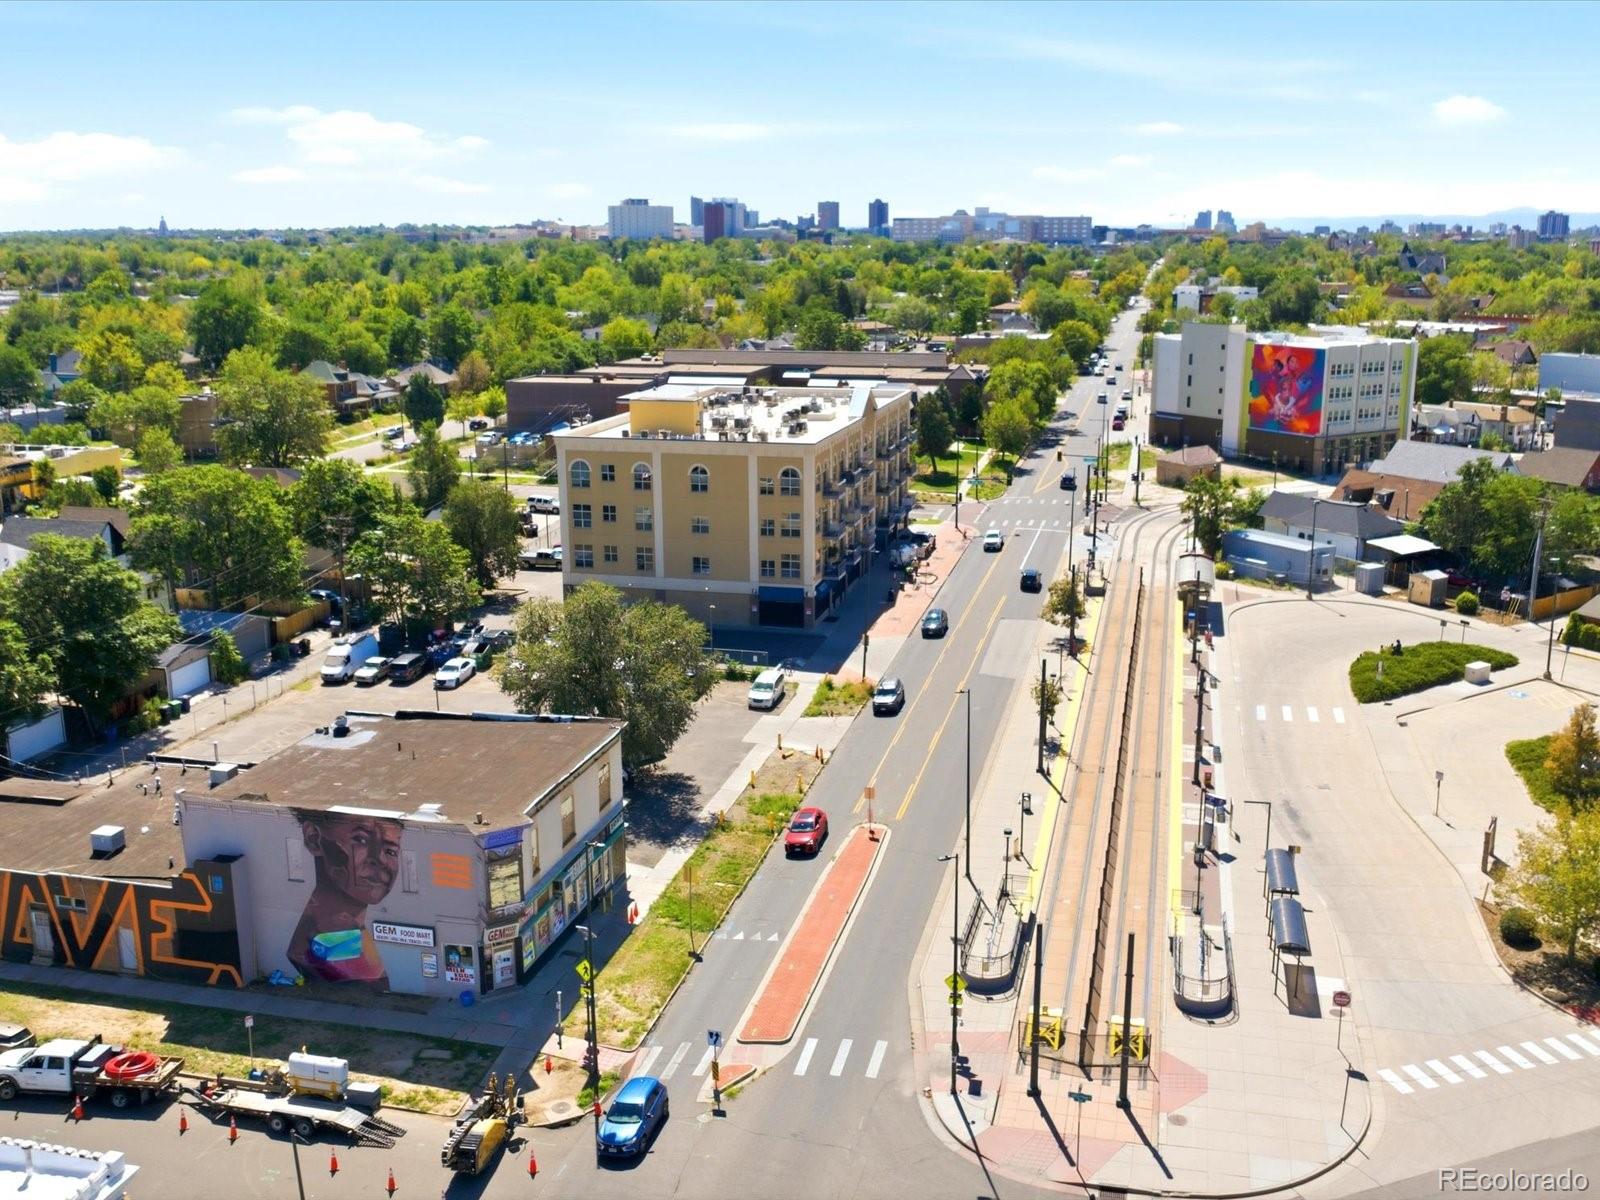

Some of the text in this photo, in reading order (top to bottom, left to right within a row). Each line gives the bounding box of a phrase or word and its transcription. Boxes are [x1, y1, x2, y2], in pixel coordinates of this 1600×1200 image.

[375, 925, 431, 940] GEM FOOD MART
[488, 928, 506, 942] GEM
